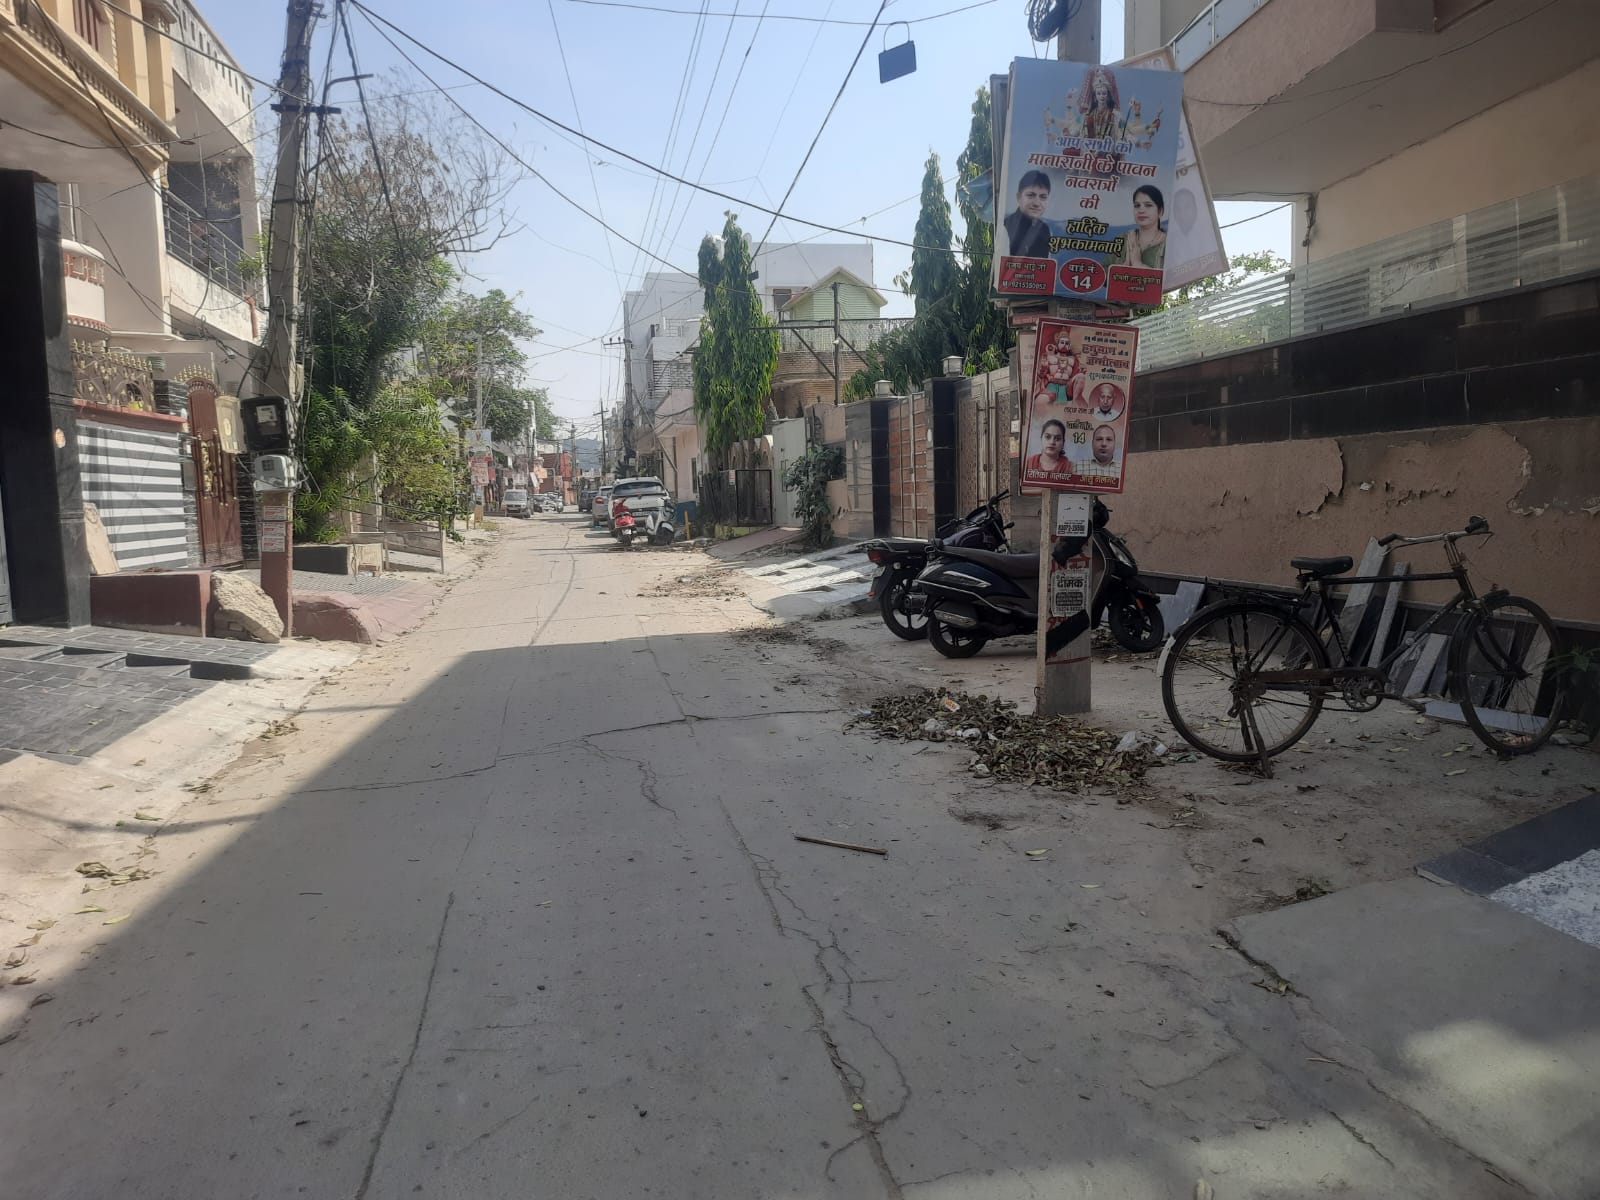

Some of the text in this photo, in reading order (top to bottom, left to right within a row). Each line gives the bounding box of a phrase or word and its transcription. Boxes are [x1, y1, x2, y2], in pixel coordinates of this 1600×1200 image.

[1056, 135, 1133, 154] आप सभी को
[1027, 152, 1158, 177] मातारानी के पावन
[1065, 175, 1120, 193] नवरात्रों
[1079, 194, 1101, 210] की
[1065, 216, 1109, 237] हार्दिक
[1068, 263, 1086, 273] वार्ड
[1071, 274, 1092, 289] 14
[1072, 431, 1086, 445] 14
[1056, 576, 1084, 588] दीमक
